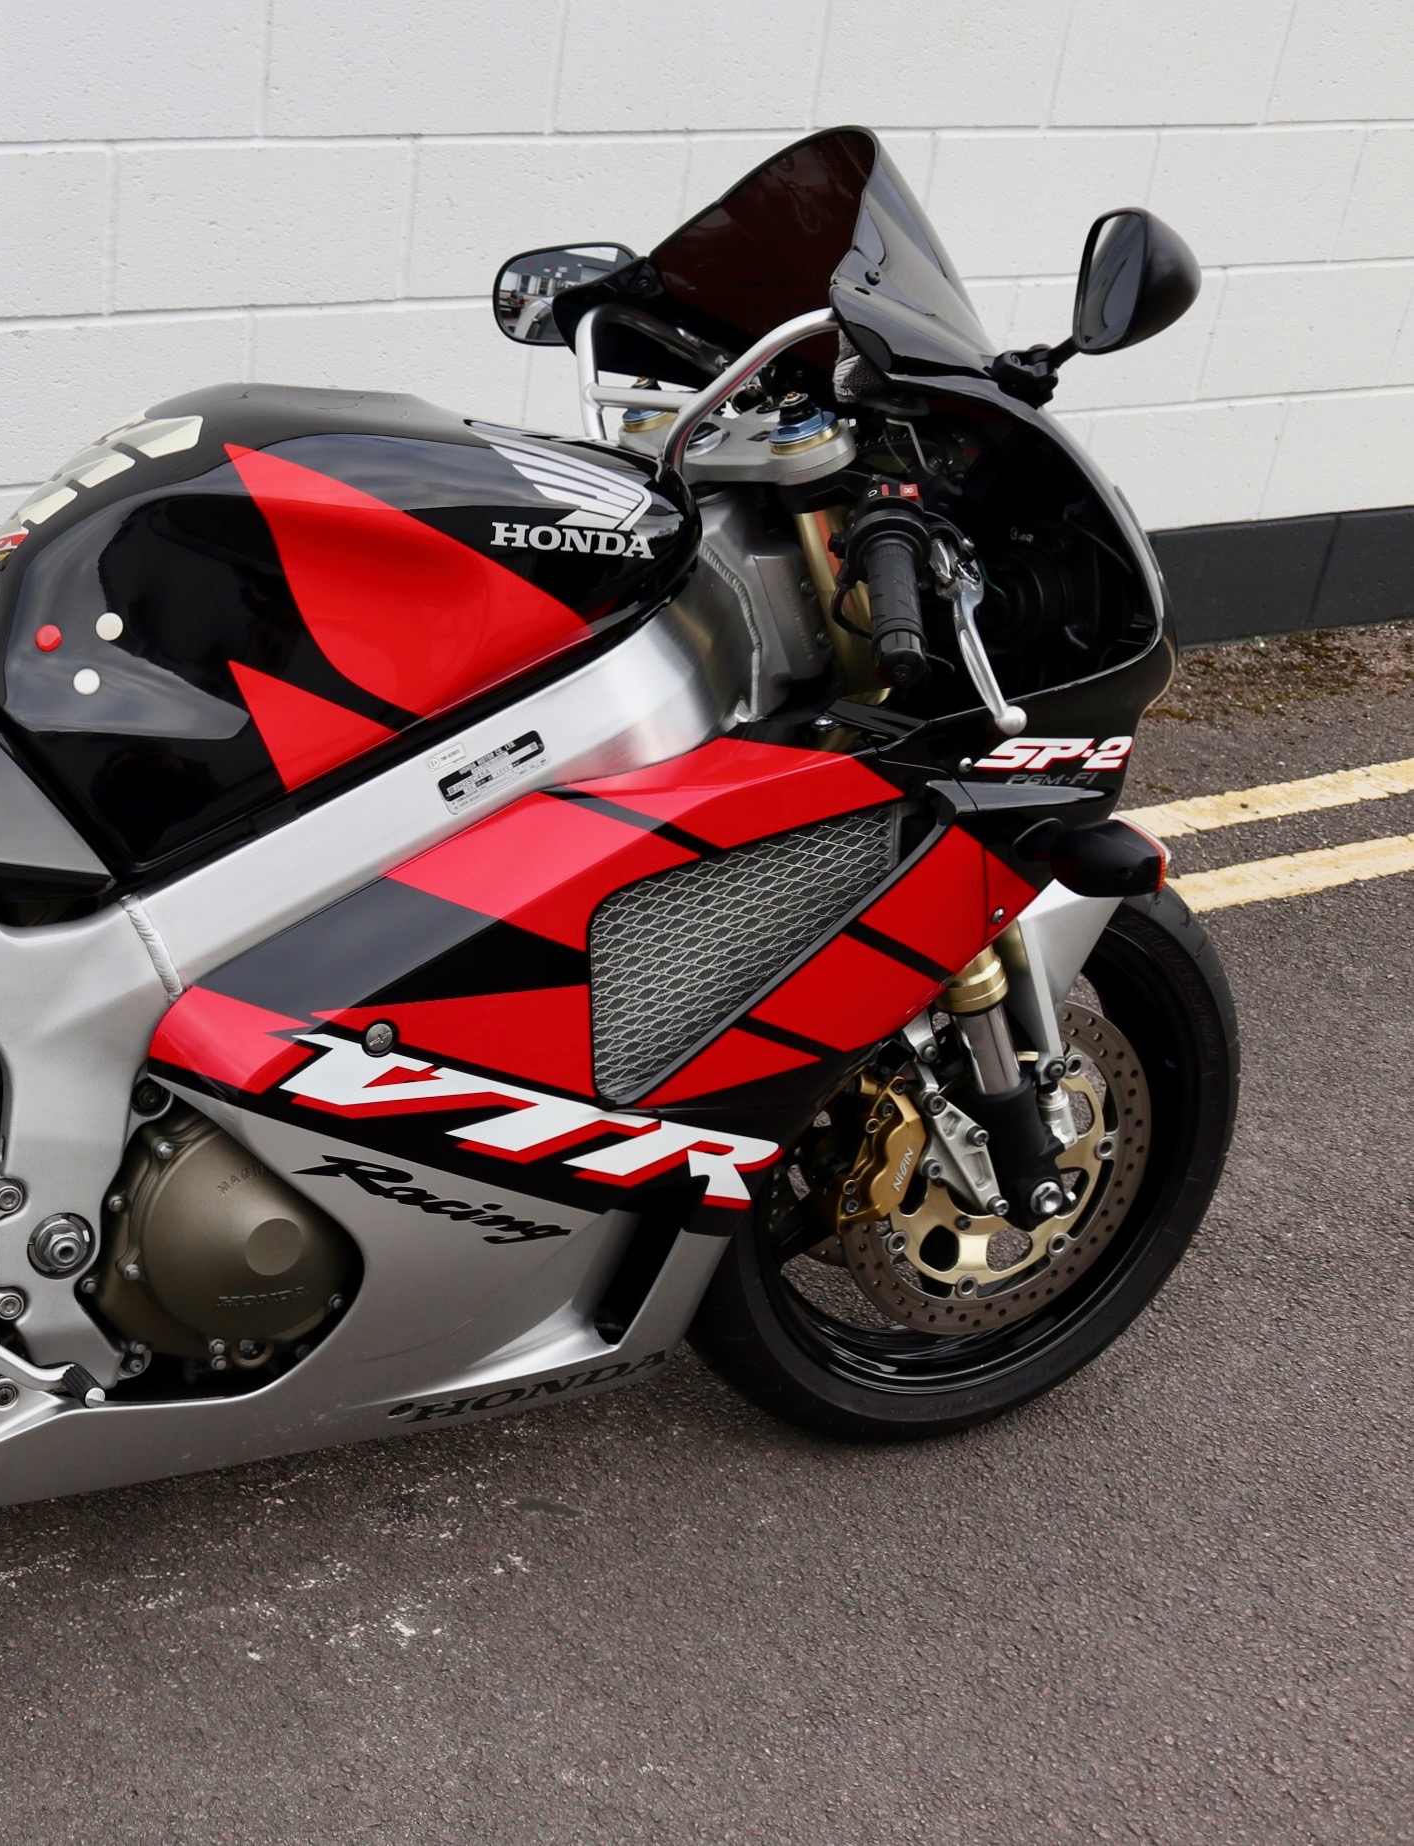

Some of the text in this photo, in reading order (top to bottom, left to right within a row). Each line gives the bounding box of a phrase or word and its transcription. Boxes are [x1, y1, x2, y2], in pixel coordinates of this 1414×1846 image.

[491, 522, 655, 560] HONDA
[279, 1032, 783, 1210] VTR
[291, 1154, 573, 1245] Racing
[404, 1349, 666, 1424] HONDA
